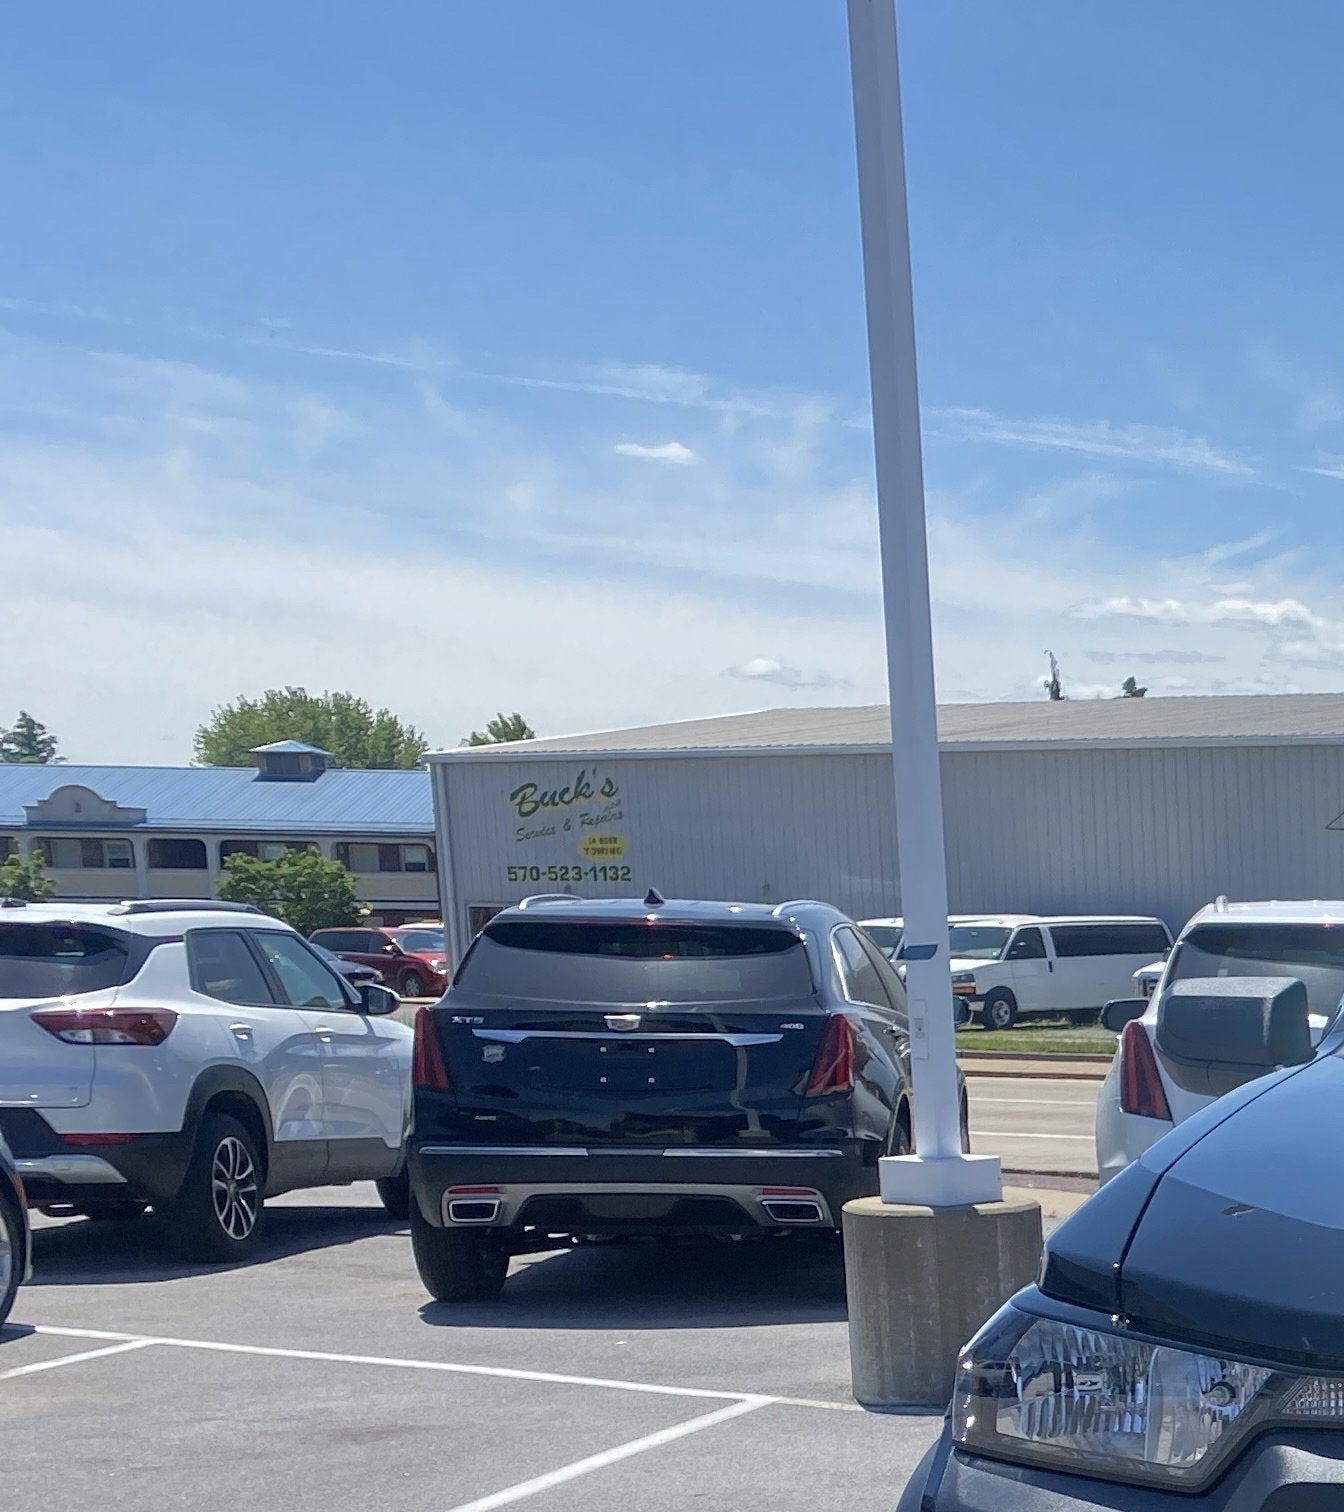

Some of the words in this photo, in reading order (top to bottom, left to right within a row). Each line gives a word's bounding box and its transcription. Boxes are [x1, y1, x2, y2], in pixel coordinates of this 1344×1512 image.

[510, 767, 619, 818] Buck's
[563, 819, 571, 832] &
[507, 866, 631, 881] 570-523-1132
